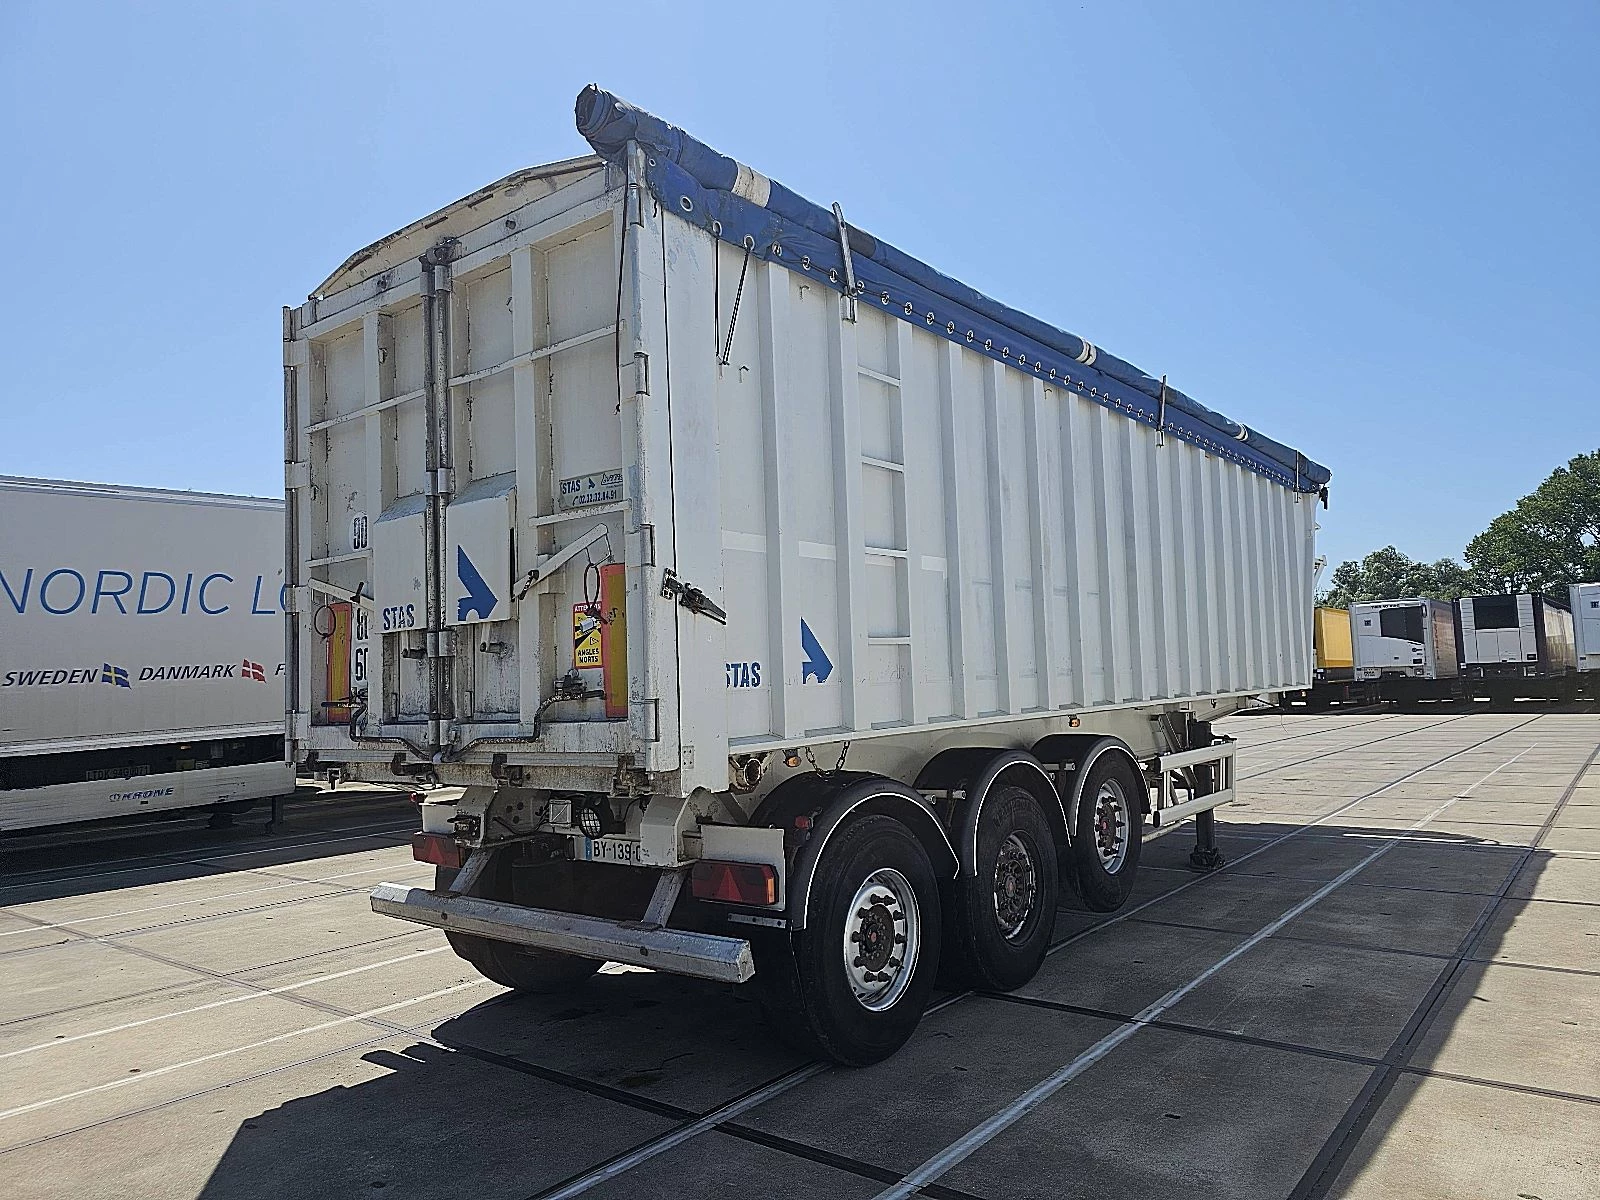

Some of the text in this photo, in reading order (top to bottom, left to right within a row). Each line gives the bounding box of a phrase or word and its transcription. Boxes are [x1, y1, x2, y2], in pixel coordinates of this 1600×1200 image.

[562, 480, 581, 494] STAS
[353, 516, 368, 549] 90
[0, 568, 286, 615] NORDIC L
[383, 604, 415, 630] STAS
[2, 663, 286, 687] SWEDEN DANMARK F
